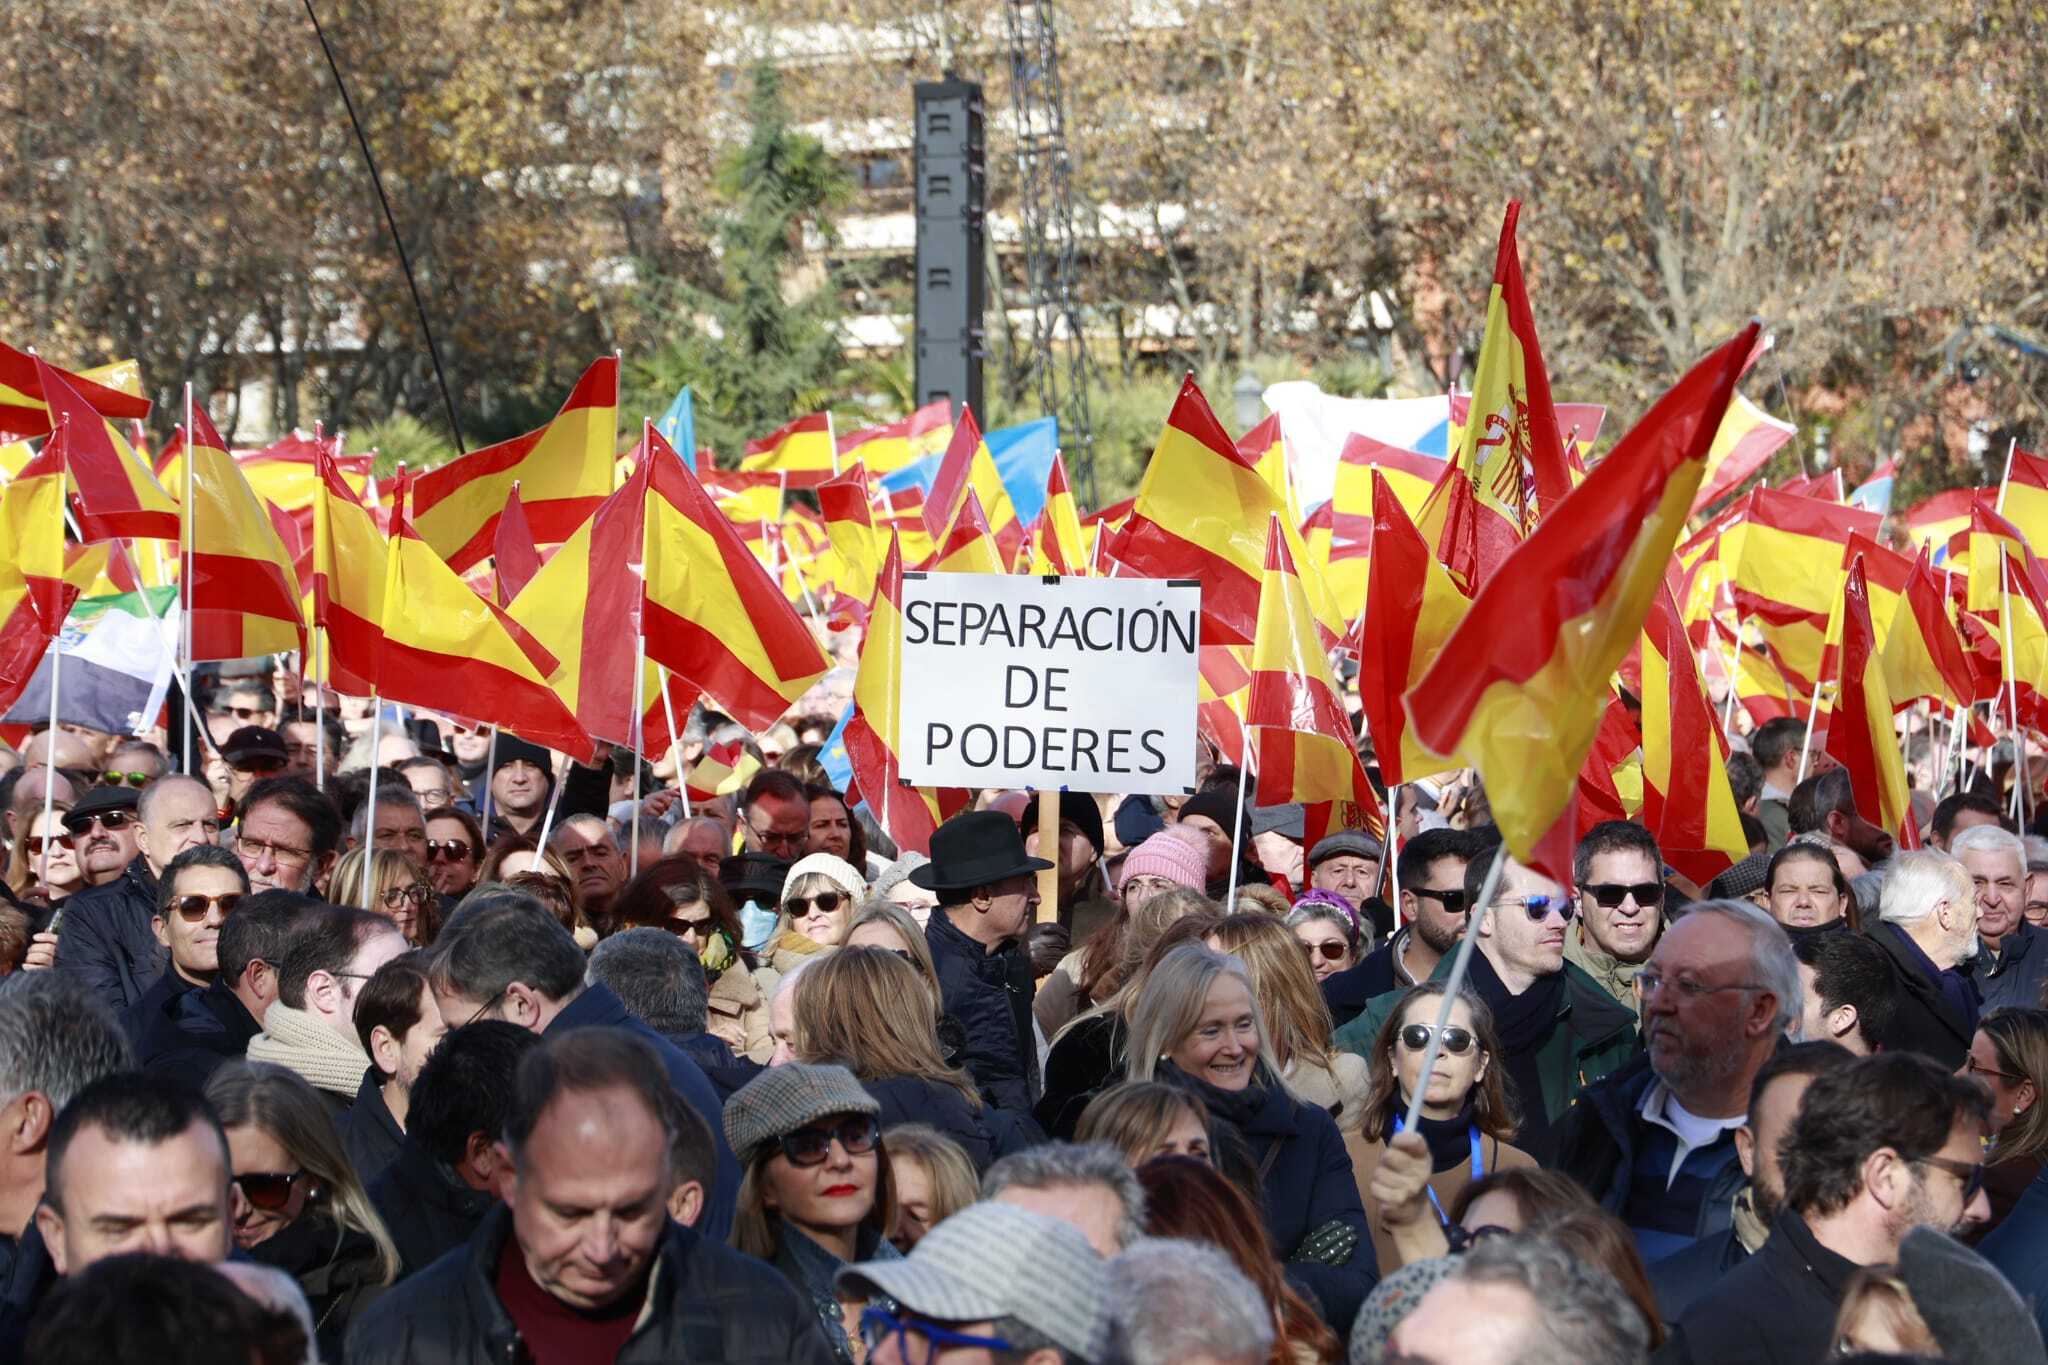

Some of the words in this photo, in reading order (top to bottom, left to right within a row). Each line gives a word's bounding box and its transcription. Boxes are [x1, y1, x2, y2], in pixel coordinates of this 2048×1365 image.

[905, 600, 1196, 654] SEPARACIÓN
[1005, 664, 1070, 712] DE
[926, 722, 1166, 775] PODERES
